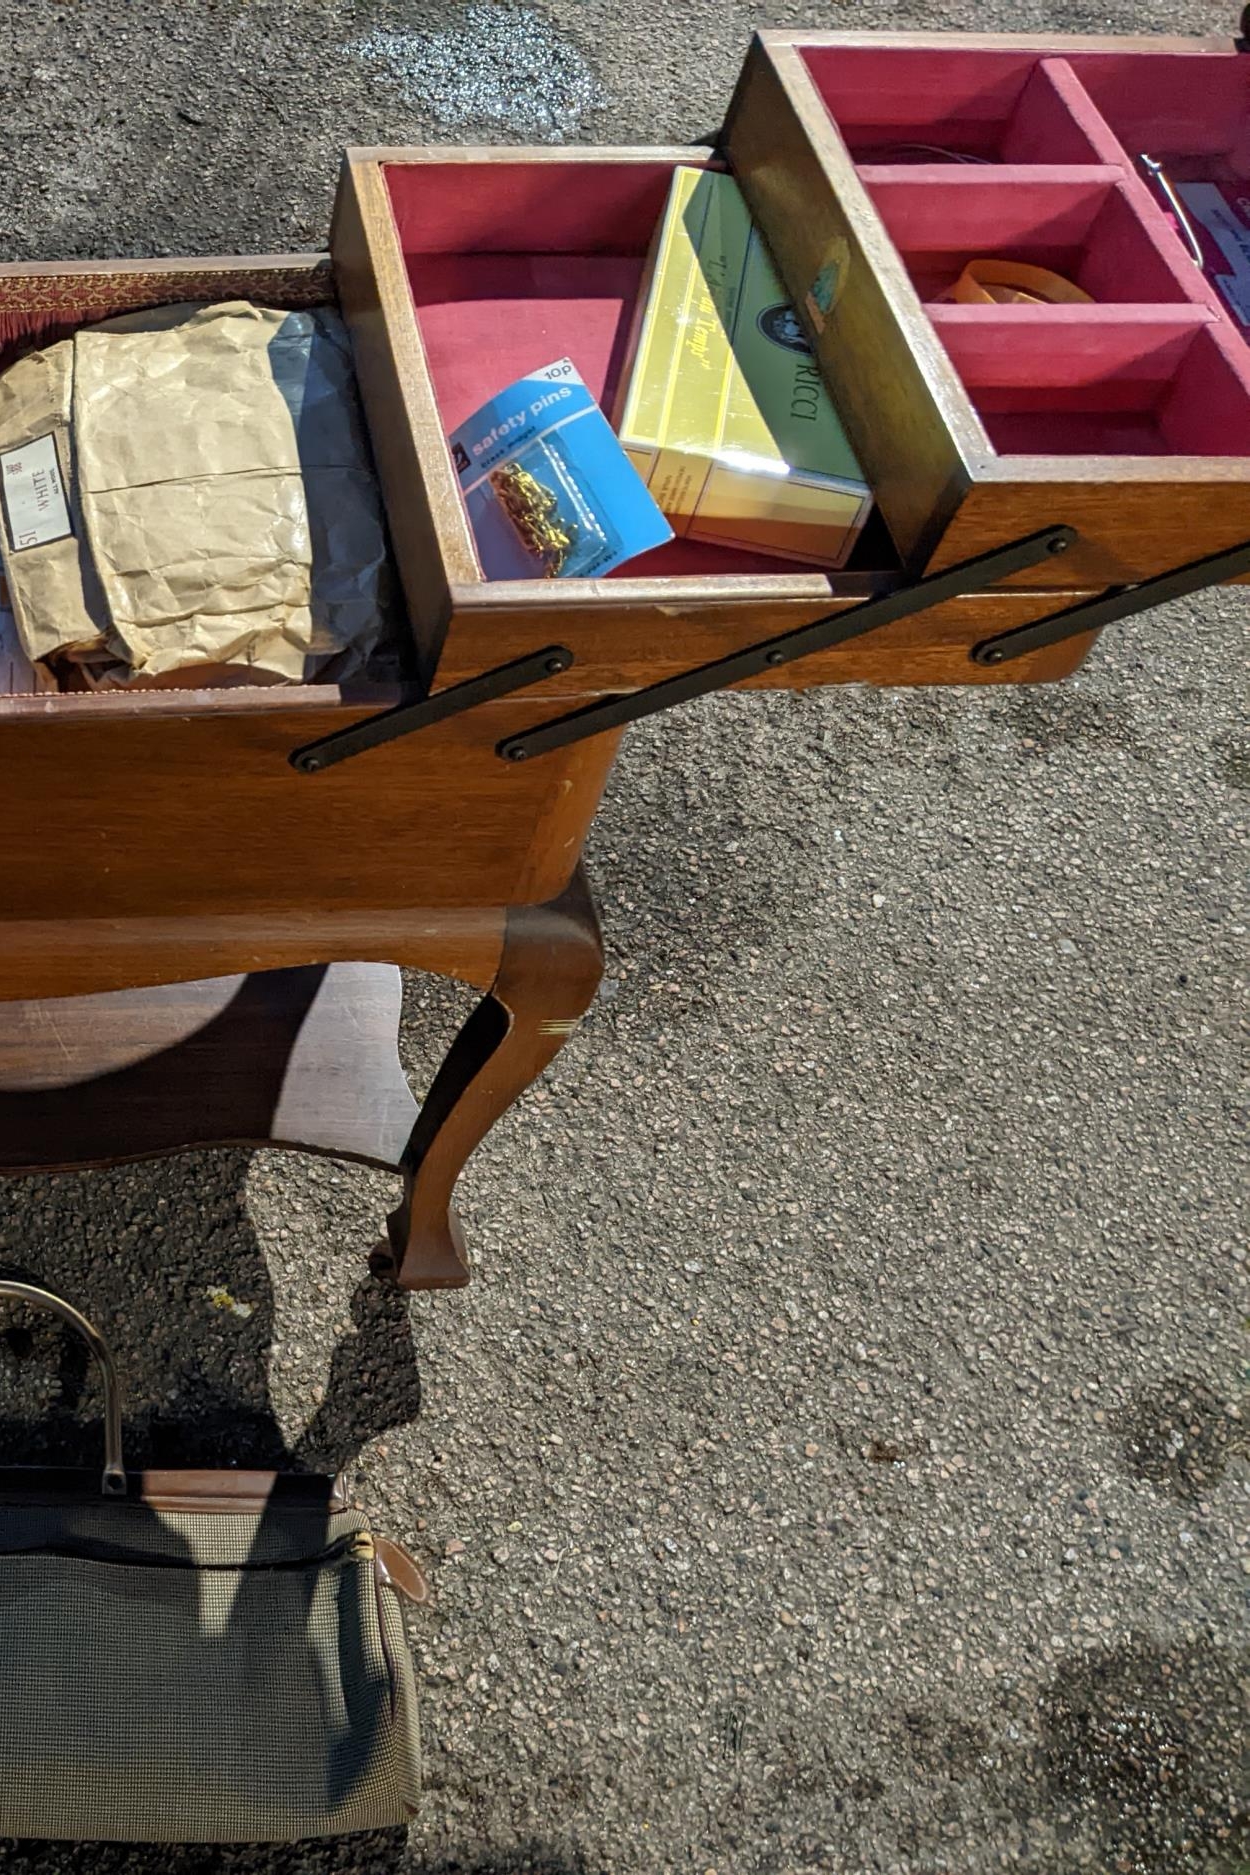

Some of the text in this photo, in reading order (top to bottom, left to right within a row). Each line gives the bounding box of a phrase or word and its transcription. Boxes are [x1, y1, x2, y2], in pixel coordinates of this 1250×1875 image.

[544, 364, 572, 380] 10p
[790, 364, 821, 421] RICCI
[472, 386, 573, 456] safety pins
[31, 468, 50, 512] WHITE
[18, 531, 38, 546] 51
